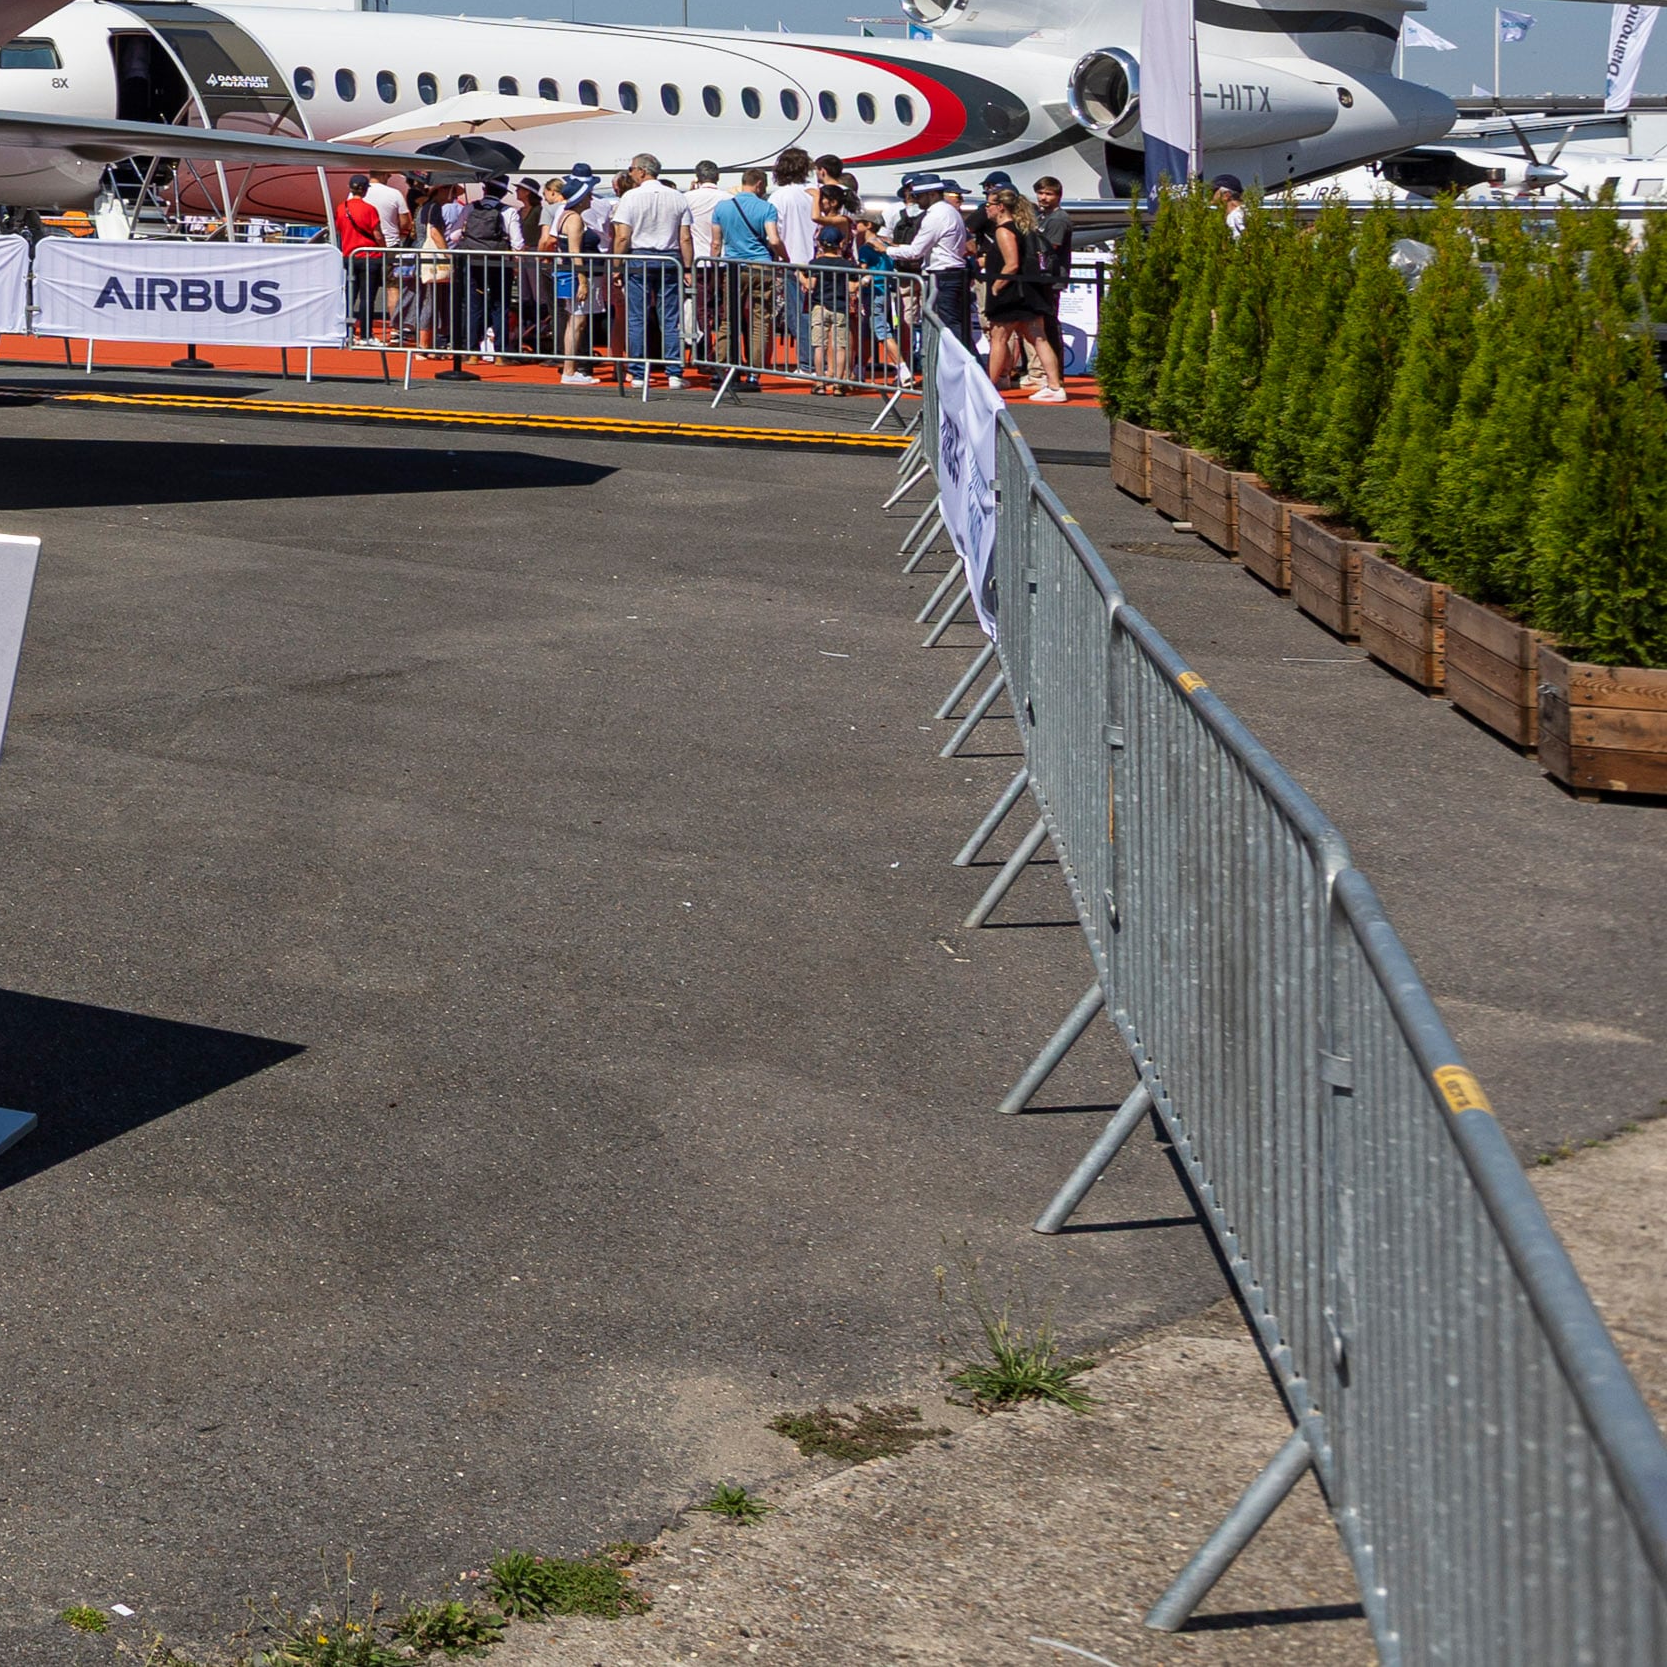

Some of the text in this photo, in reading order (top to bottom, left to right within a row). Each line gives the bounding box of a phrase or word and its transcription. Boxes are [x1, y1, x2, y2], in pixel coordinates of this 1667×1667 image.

[52, 77, 69, 89] 8X
[1200, 83, 1271, 113] -HITX
[94, 276, 282, 316] AIRBUS
